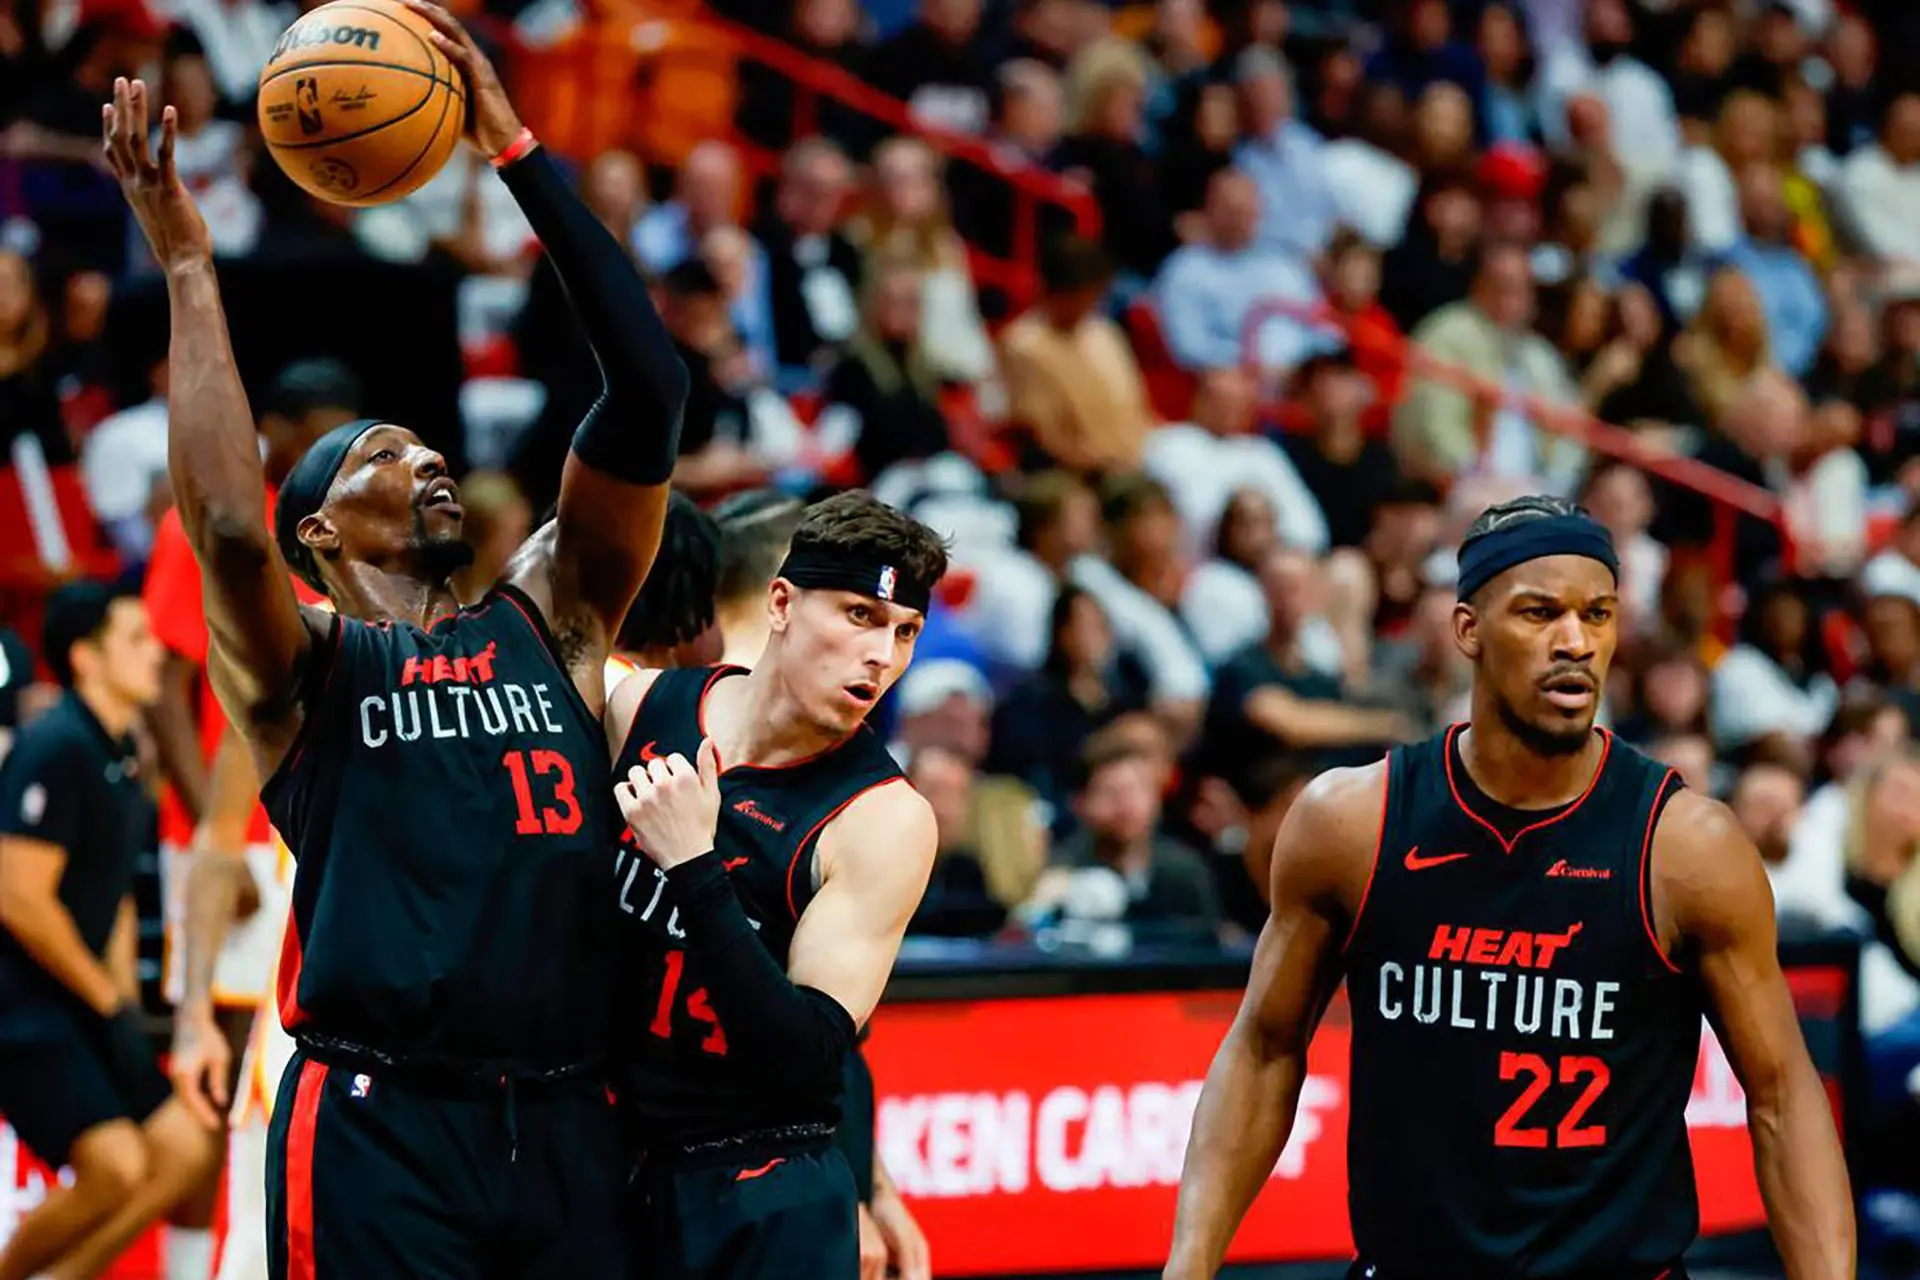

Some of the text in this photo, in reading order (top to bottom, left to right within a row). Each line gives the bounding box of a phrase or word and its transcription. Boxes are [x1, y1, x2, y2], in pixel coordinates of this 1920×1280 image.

[402, 641, 497, 686] HEAT
[360, 683, 563, 748] CULTURE
[503, 749, 583, 835] 13
[1560, 865, 1611, 879] Carnival
[1428, 920, 1583, 969] HEAT
[1378, 960, 1621, 1040] CULTURE
[1494, 1050, 1611, 1148] 22
